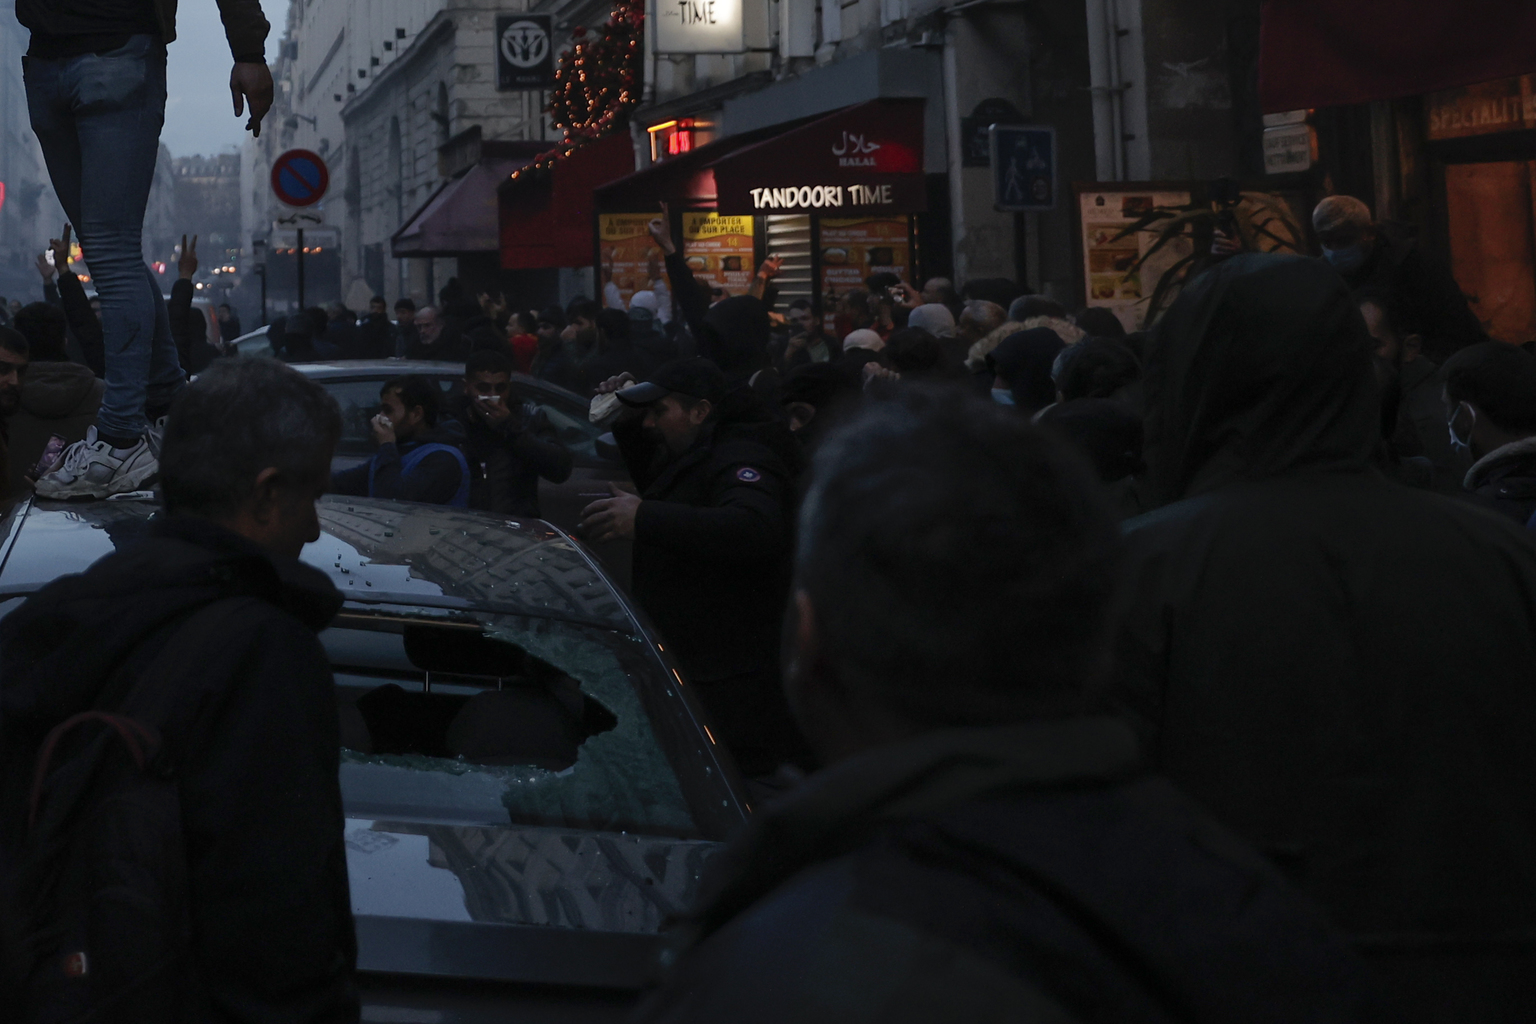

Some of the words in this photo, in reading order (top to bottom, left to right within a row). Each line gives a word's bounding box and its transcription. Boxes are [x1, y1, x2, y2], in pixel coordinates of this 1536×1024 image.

[679, 0, 716, 24] TIME
[832, 130, 881, 157] حلال
[839, 157, 877, 167] HALAL
[750, 185, 844, 209] TANDOORI
[847, 184, 893, 206] TIME
[699, 217, 741, 225] EMPORTER
